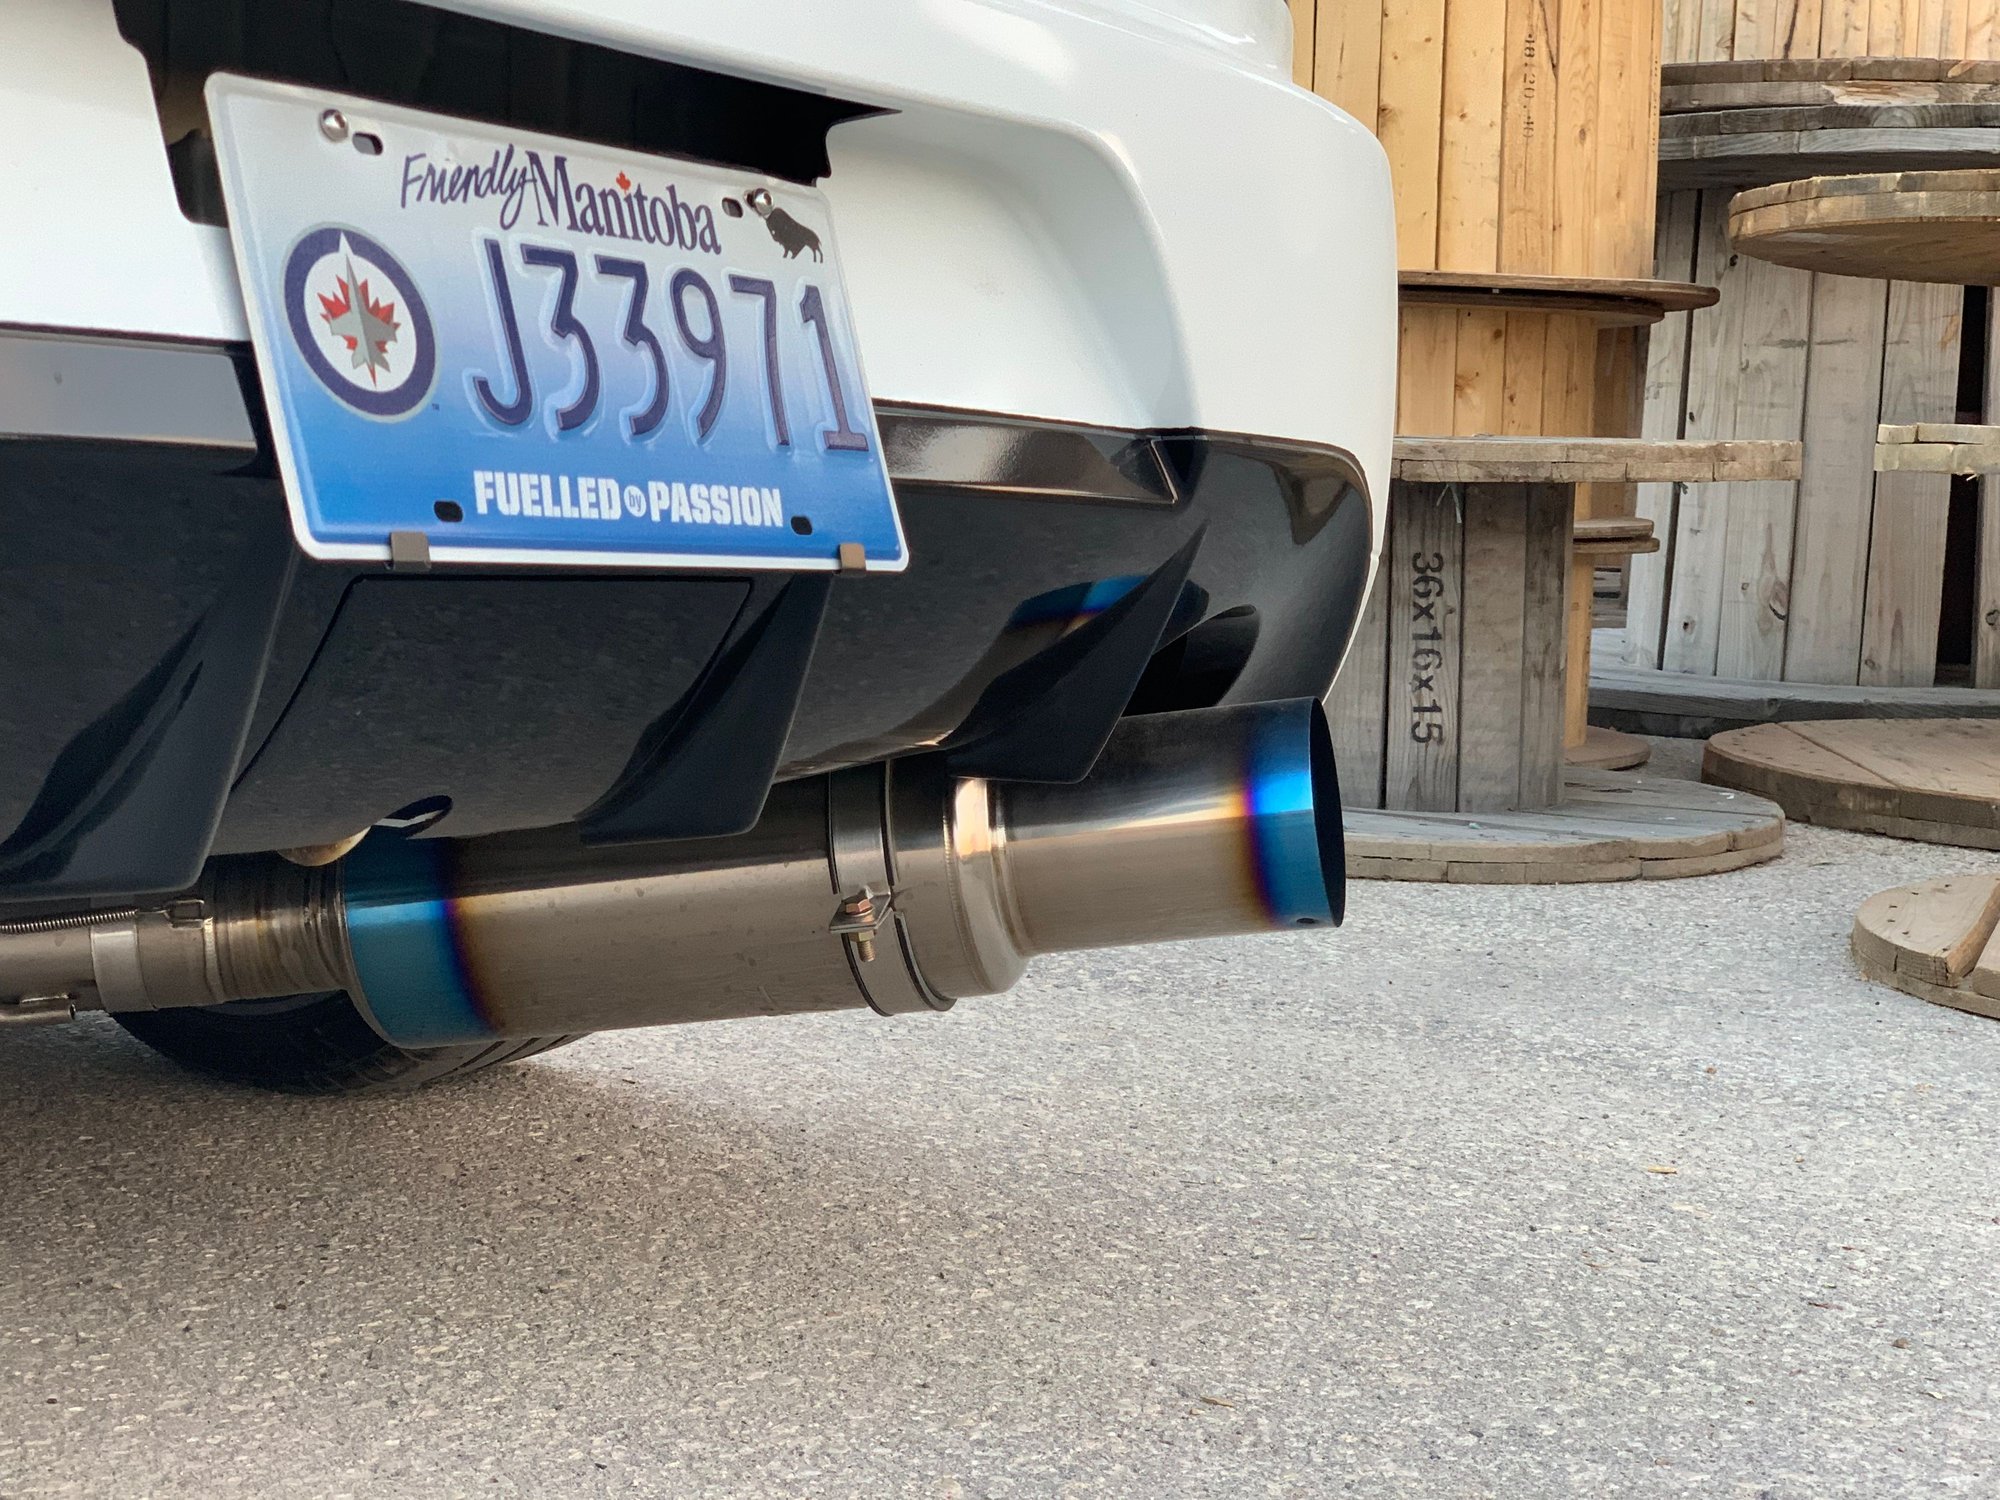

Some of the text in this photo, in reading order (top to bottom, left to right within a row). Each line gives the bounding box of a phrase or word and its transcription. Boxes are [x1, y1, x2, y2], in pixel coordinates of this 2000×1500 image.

[401, 143, 721, 255] Friendly Manitoba
[474, 238, 869, 453] J33971
[474, 470, 783, 527] FUELLED by PASSION
[1411, 552, 1444, 745] 36x16x15
